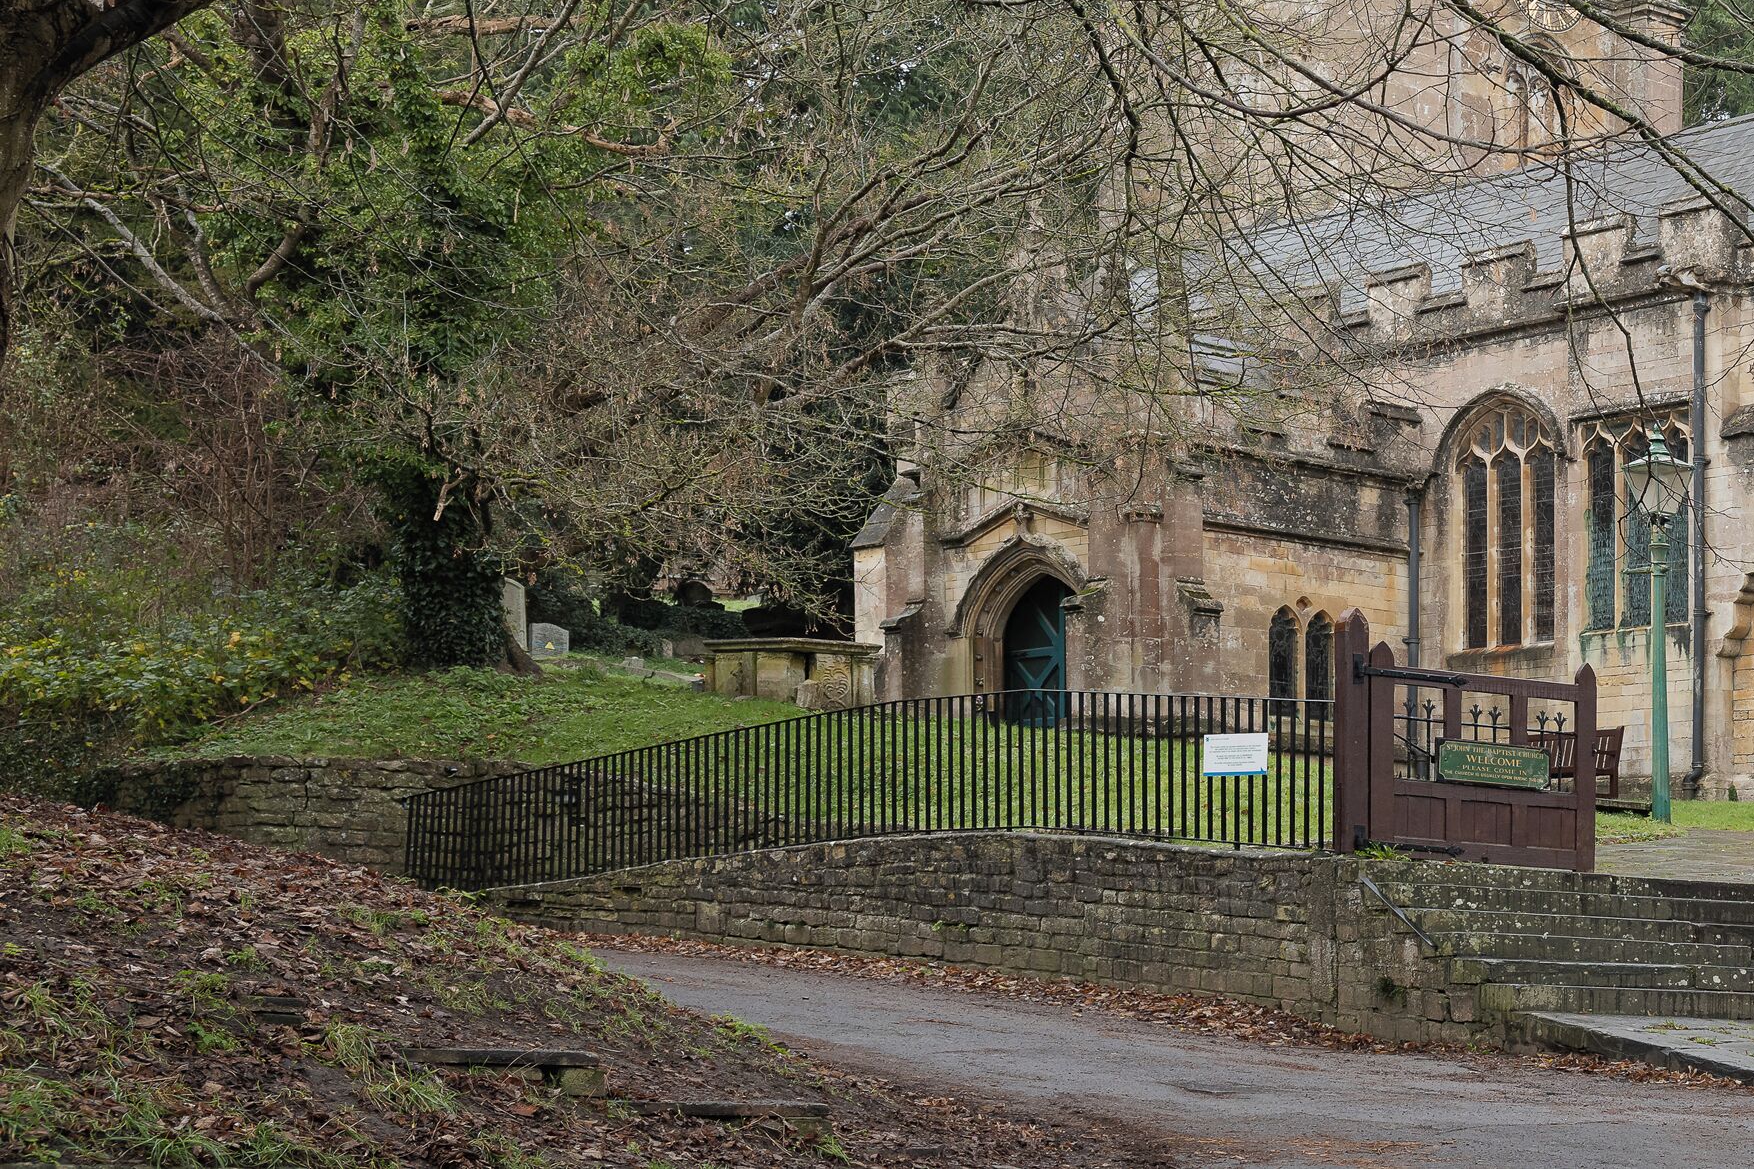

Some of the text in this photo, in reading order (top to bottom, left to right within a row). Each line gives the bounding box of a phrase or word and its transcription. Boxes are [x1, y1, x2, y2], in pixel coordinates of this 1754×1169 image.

[1452, 744, 1471, 752] JOHN
[1472, 746, 1485, 754] THE
[1487, 747, 1517, 757] BAPTIST
[1518, 750, 1544, 760] CHURCH
[1466, 754, 1523, 768] WELCOME
[1462, 764, 1489, 772] PLEASE
[1493, 767, 1516, 775] COME
